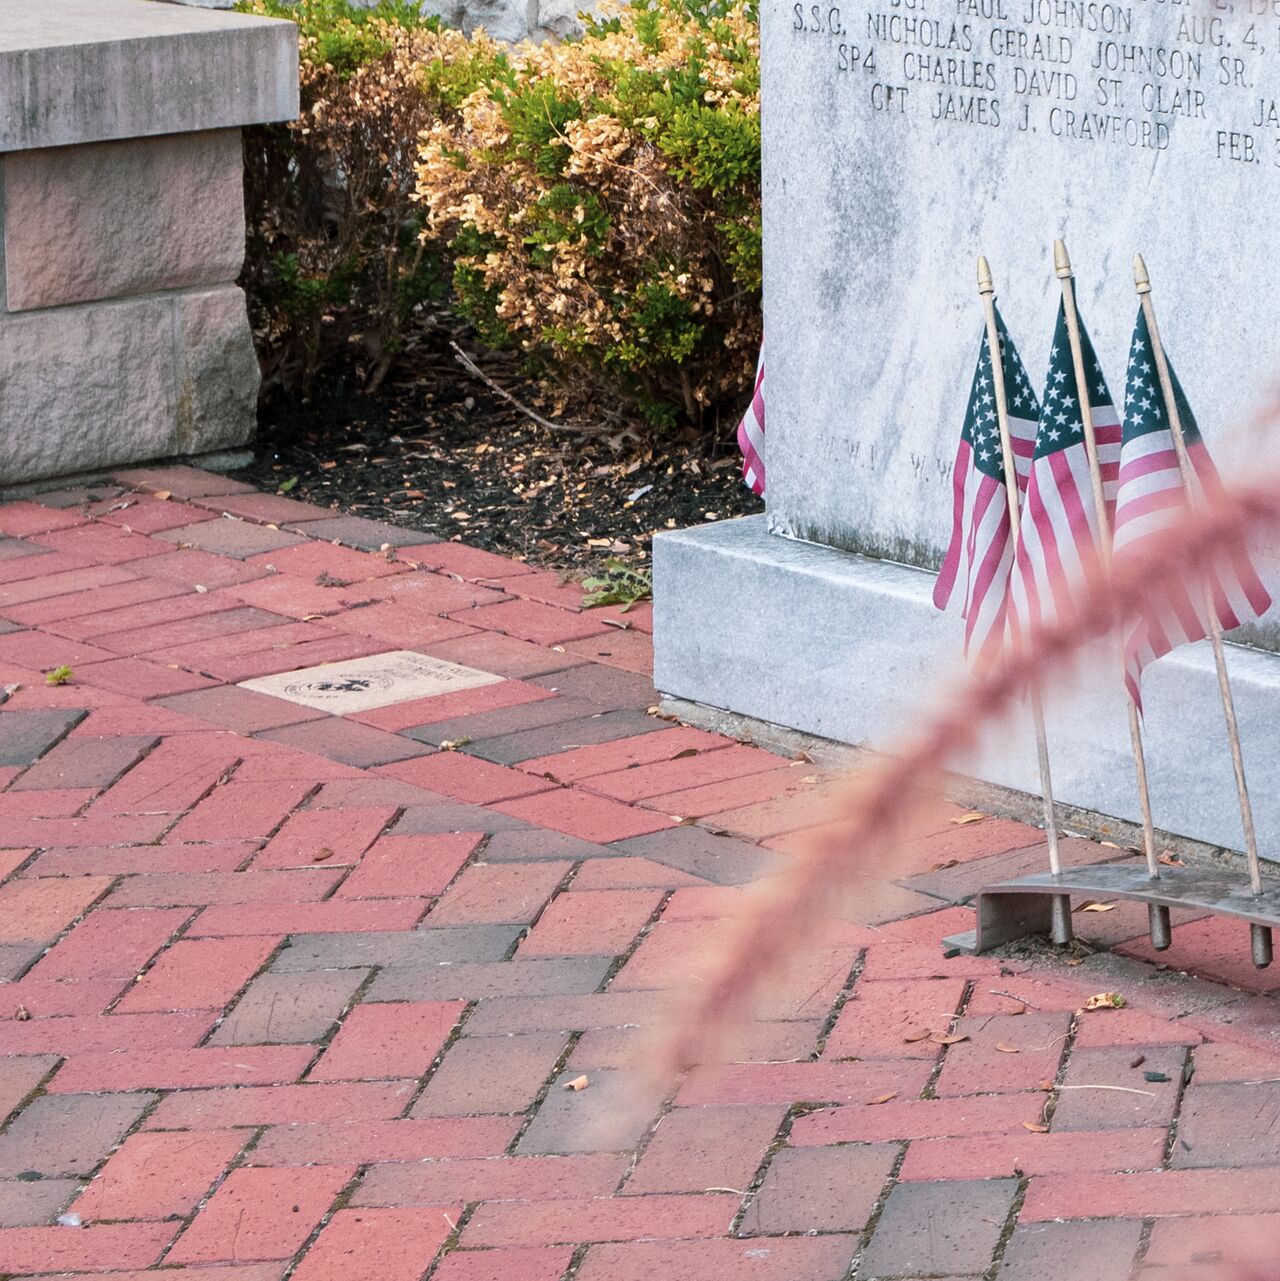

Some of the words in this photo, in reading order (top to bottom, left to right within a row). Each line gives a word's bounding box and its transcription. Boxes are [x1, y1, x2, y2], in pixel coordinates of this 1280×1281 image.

[794, 4, 847, 36] S.S.G.
[867, 13, 972, 53] NICHOLAS
[990, 28, 1073, 65] GERALD
[1092, 41, 1202, 81] JOHNSON
[1220, 56, 1253, 89] SR.
[1176, 14, 1231, 48] AUG.
[838, 44, 876, 73] SP4
[904, 52, 996, 91] CHARLES
[1014, 67, 1077, 101] DAVID
[1098, 78, 1125, 108] ST.
[1142, 83, 1207, 119] CLAIR
[932, 93, 1001, 128] JAMES
[1019, 105, 1037, 133] J.
[1050, 107, 1170, 151] CRAWFORD
[1216, 130, 1260, 165] FEB.
